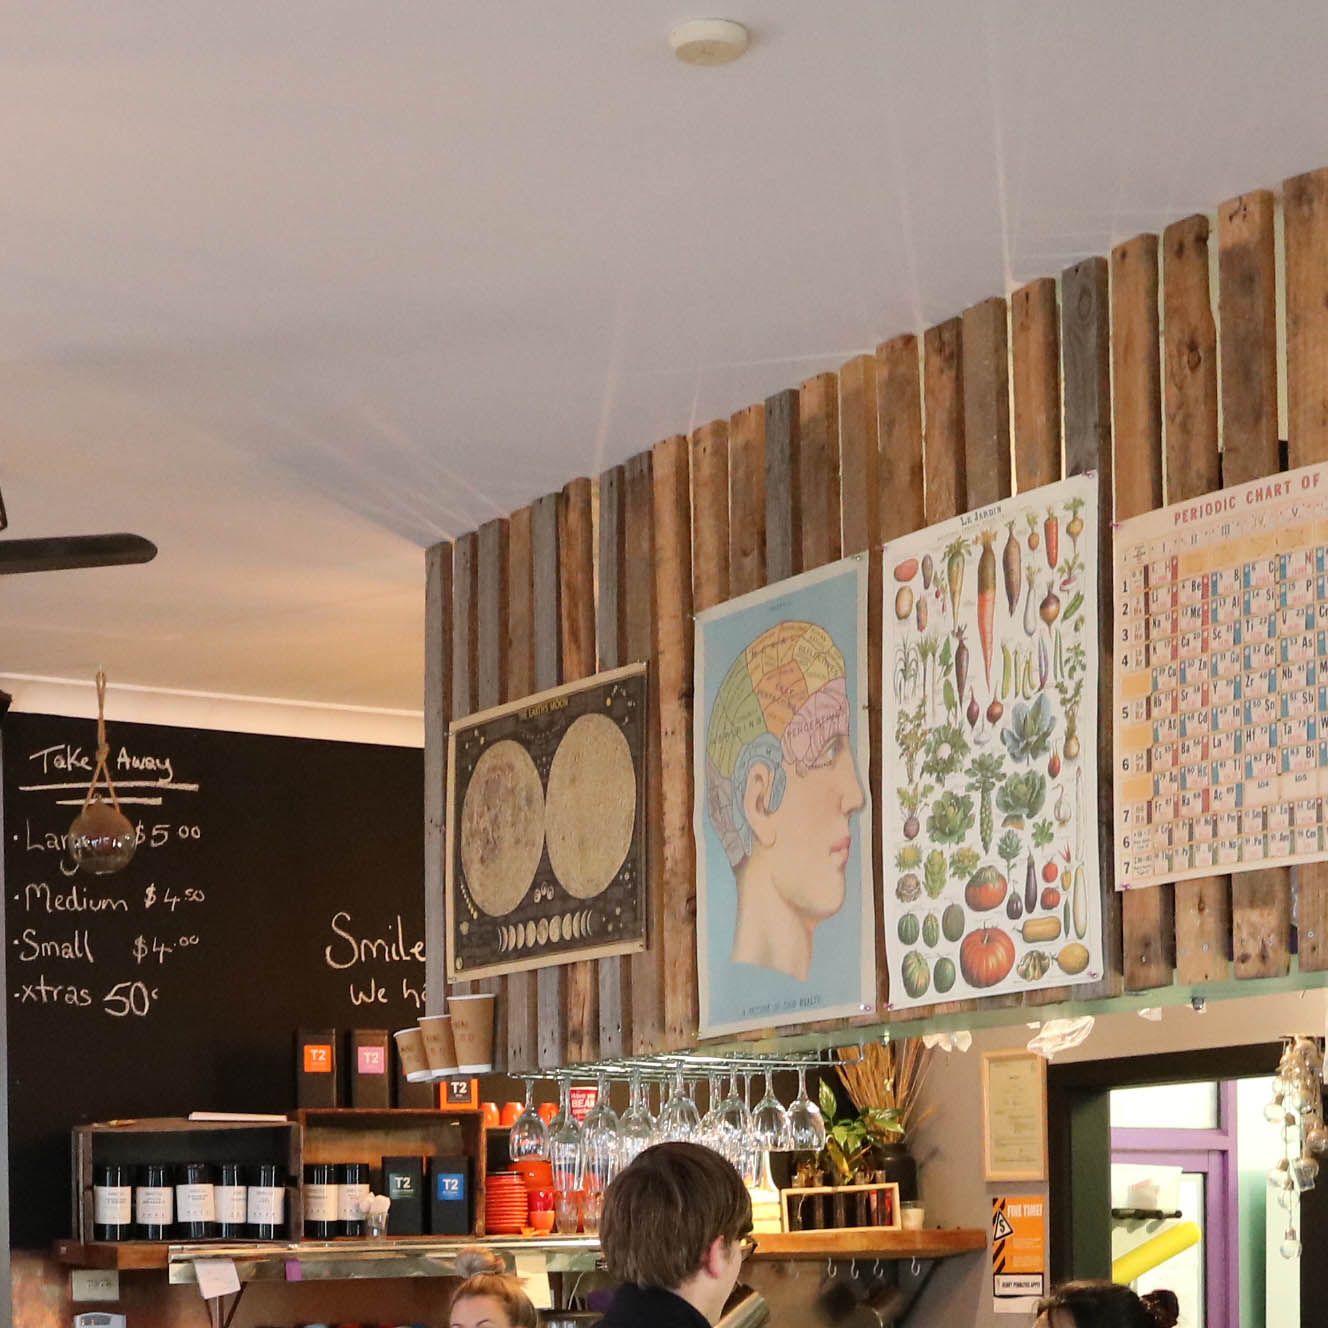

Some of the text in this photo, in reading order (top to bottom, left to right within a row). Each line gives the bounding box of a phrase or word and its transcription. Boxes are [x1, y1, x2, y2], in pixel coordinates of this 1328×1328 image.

[1174, 496, 1236, 525] PERIODIC
[1246, 481, 1291, 504] CHART
[1301, 473, 1320, 489] OF
[29, 744, 173, 781] Take Away
[25, 882, 129, 913] Medium
[20, 929, 94, 963] Small
[325, 912, 426, 969] Smile
[350, 978, 388, 1005] We
[310, 1049, 326, 1061] T2
[363, 1052, 379, 1064] T2
[450, 1081, 467, 1094] T2
[395, 1176, 412, 1189] T2
[442, 1178, 459, 1191] T2
